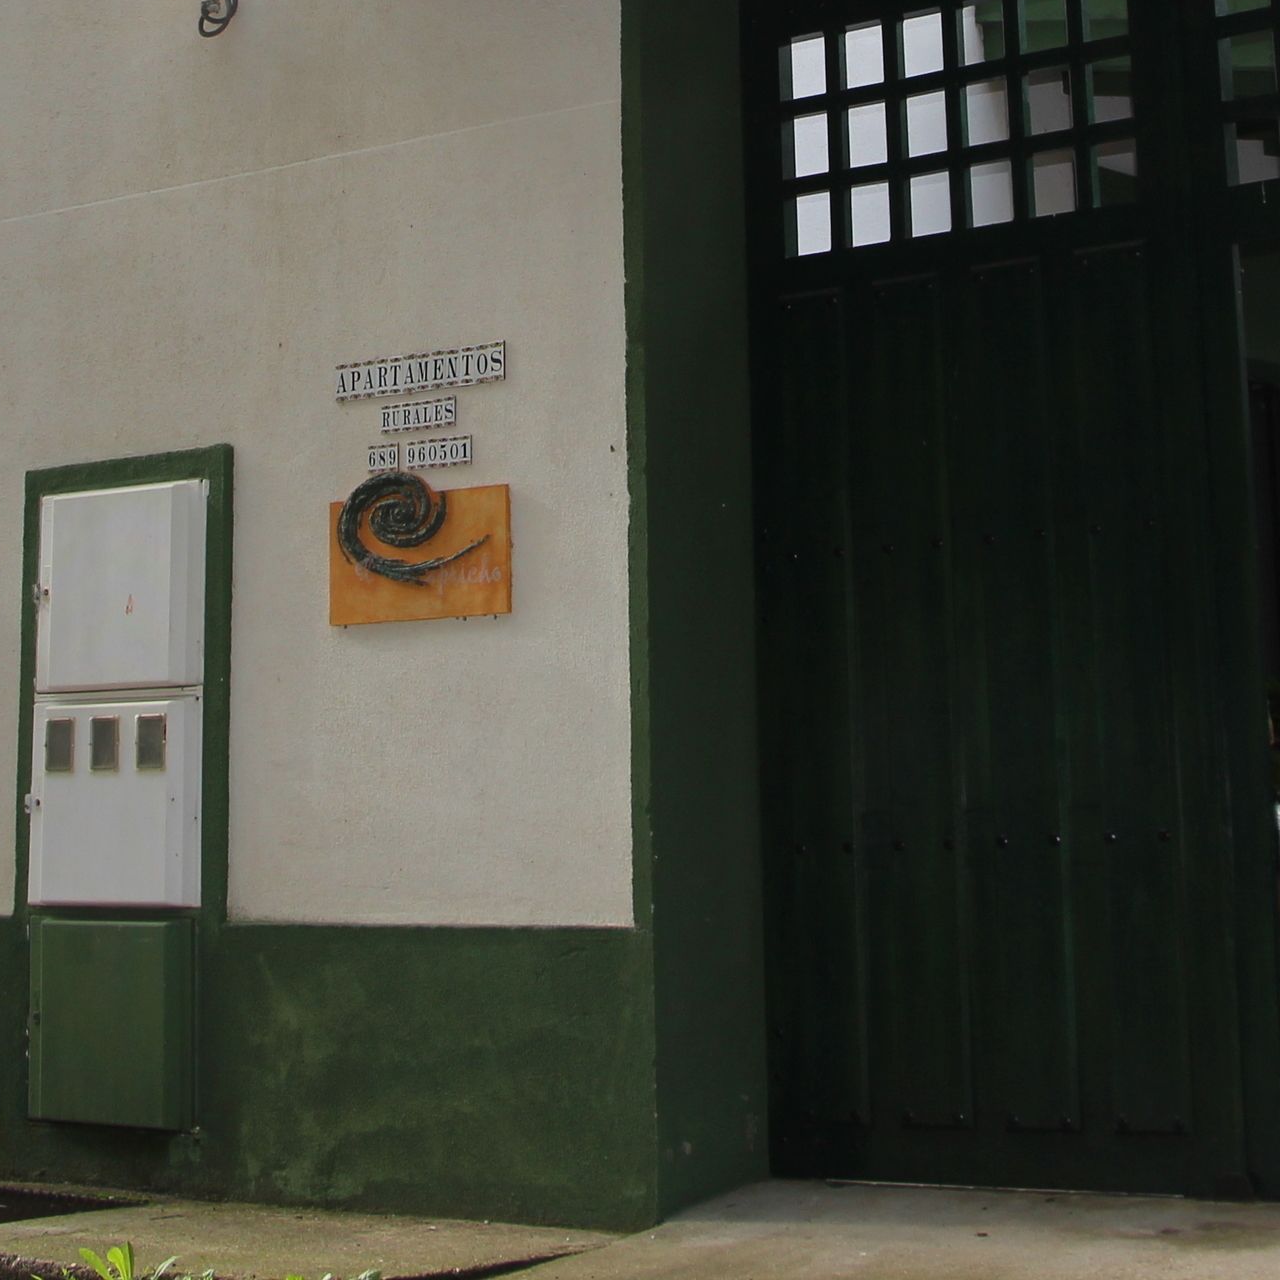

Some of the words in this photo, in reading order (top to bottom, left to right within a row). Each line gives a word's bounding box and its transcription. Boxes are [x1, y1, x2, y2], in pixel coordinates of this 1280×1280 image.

[336, 350, 503, 394] APARTAMENTOS
[382, 402, 455, 428] RURALES
[368, 448, 397, 468] 689
[407, 442, 469, 464] 960501
